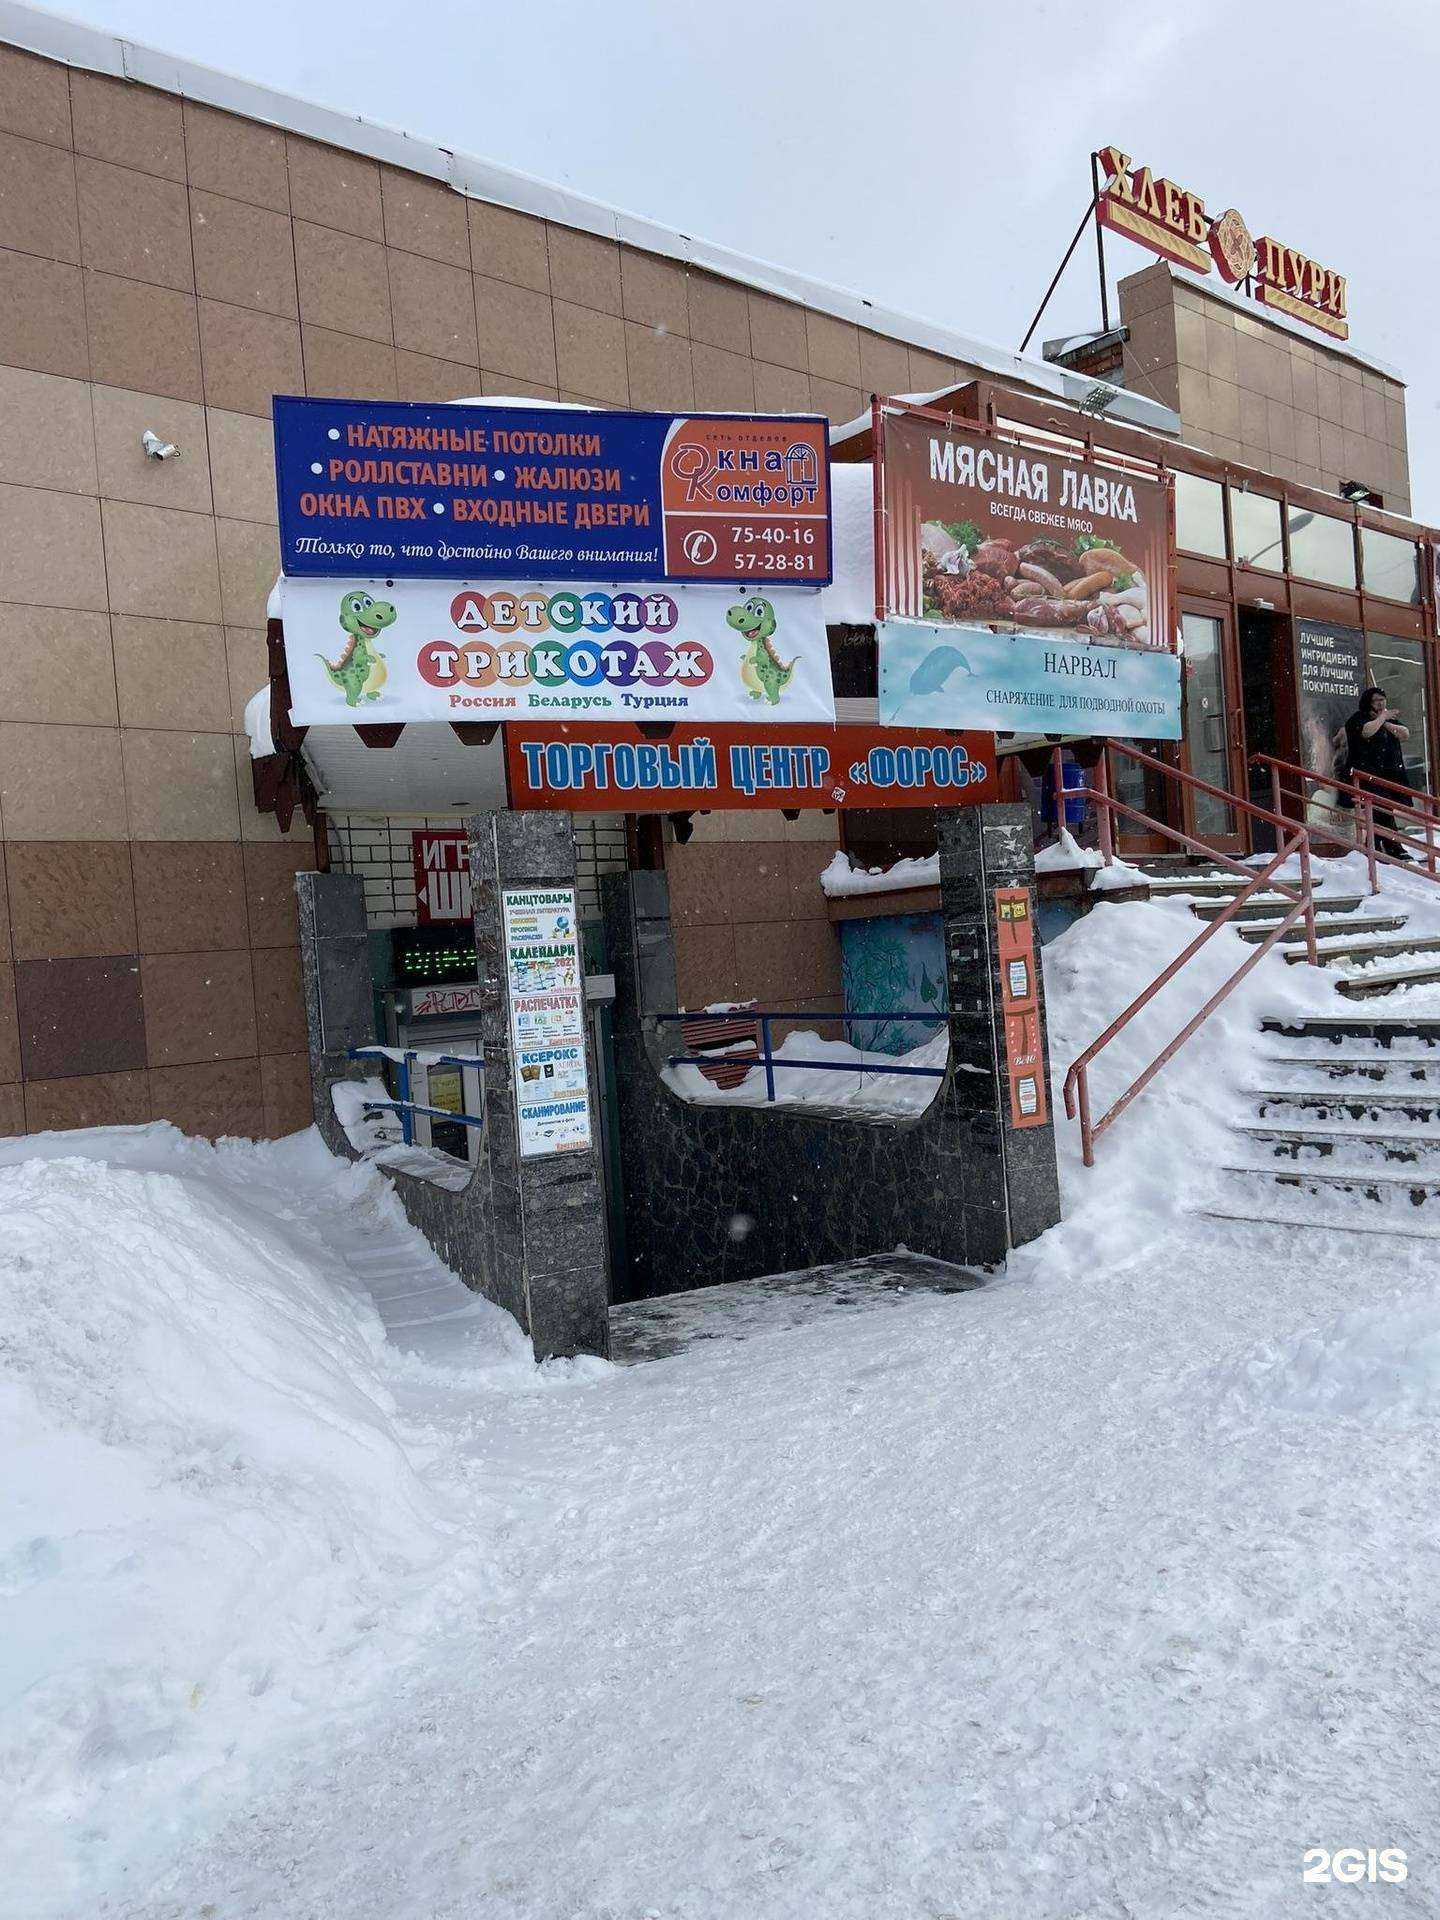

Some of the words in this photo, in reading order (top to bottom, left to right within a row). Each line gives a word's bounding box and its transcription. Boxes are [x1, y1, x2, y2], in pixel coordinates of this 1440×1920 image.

[1100, 146, 1209, 243] ХЛЕБ
[1256, 236, 1348, 319] ПУРИ
[346, 424, 486, 453] НАТЯЖНЫЕ
[492, 430, 601, 457] ПОТОЛКИ
[328, 458, 487, 487] РОЛЛСТАВНИ
[514, 465, 621, 492] ЖАЛЮЗИ
[929, 438, 1049, 503] МЯСНАЯ
[1059, 470, 1139, 524] ЛАВКА
[300, 492, 371, 518] ОКНА
[376, 496, 427, 520] ПВХ
[452, 499, 569, 528] ВХОДНЫЕ
[574, 503, 651, 530] ДВЕРИ
[990, 501, 1026, 521] ВСЕГДА
[1028, 509, 1066, 528] СВЕЖЕЕ
[1067, 517, 1093, 534] МЯСО
[731, 526, 815, 544] 75-40-16
[295, 537, 365, 559] Только
[369, 544, 396, 559] то,
[400, 545, 433, 558] что
[437, 539, 512, 561] достойно
[515, 543, 573, 561] Вашего
[577, 547, 658, 563] внимания!
[734, 553, 815, 571] 57-28-81
[456, 594, 672, 630] ДЕТСКИЙ
[1300, 632, 1335, 648] ЛУЧШИЕ
[429, 650, 707, 679] ТРИКОТАЖ
[1043, 652, 1117, 679] НАРВАЛ
[1300, 647, 1358, 667] ИНГРИДИЕНТЫ
[1302, 664, 1319, 677] ДЛЯ
[1320, 666, 1354, 681] ЛУЧШИХ
[1303, 680, 1359, 697] ПОКУПАТЕЛЕЙ
[449, 694, 517, 708] Россия
[528, 694, 612, 709] Беларусь
[621, 693, 689, 709] Турция
[986, 690, 1055, 707] СНАРЯЖЕНИЕ
[1058, 694, 1078, 709] ДЛЯ
[1080, 696, 1134, 713] ПОДВОДНОЙ
[1135, 700, 1165, 715] ОХОТЫ
[520, 737, 718, 790] ТОРГОВЫЙ
[729, 744, 830, 796] ЦЕНТР
[849, 746, 987, 788] «ФОРОС»
[506, 893, 572, 907] КАНЦТОВАРЫ
[510, 944, 576, 959] КАЛЕНДАРИ
[514, 995, 579, 1013] РАСПЕЧАТКА
[521, 1047, 578, 1064] КСЕРОКС
[521, 1100, 586, 1119] СКАНИРОВАНИЕ
